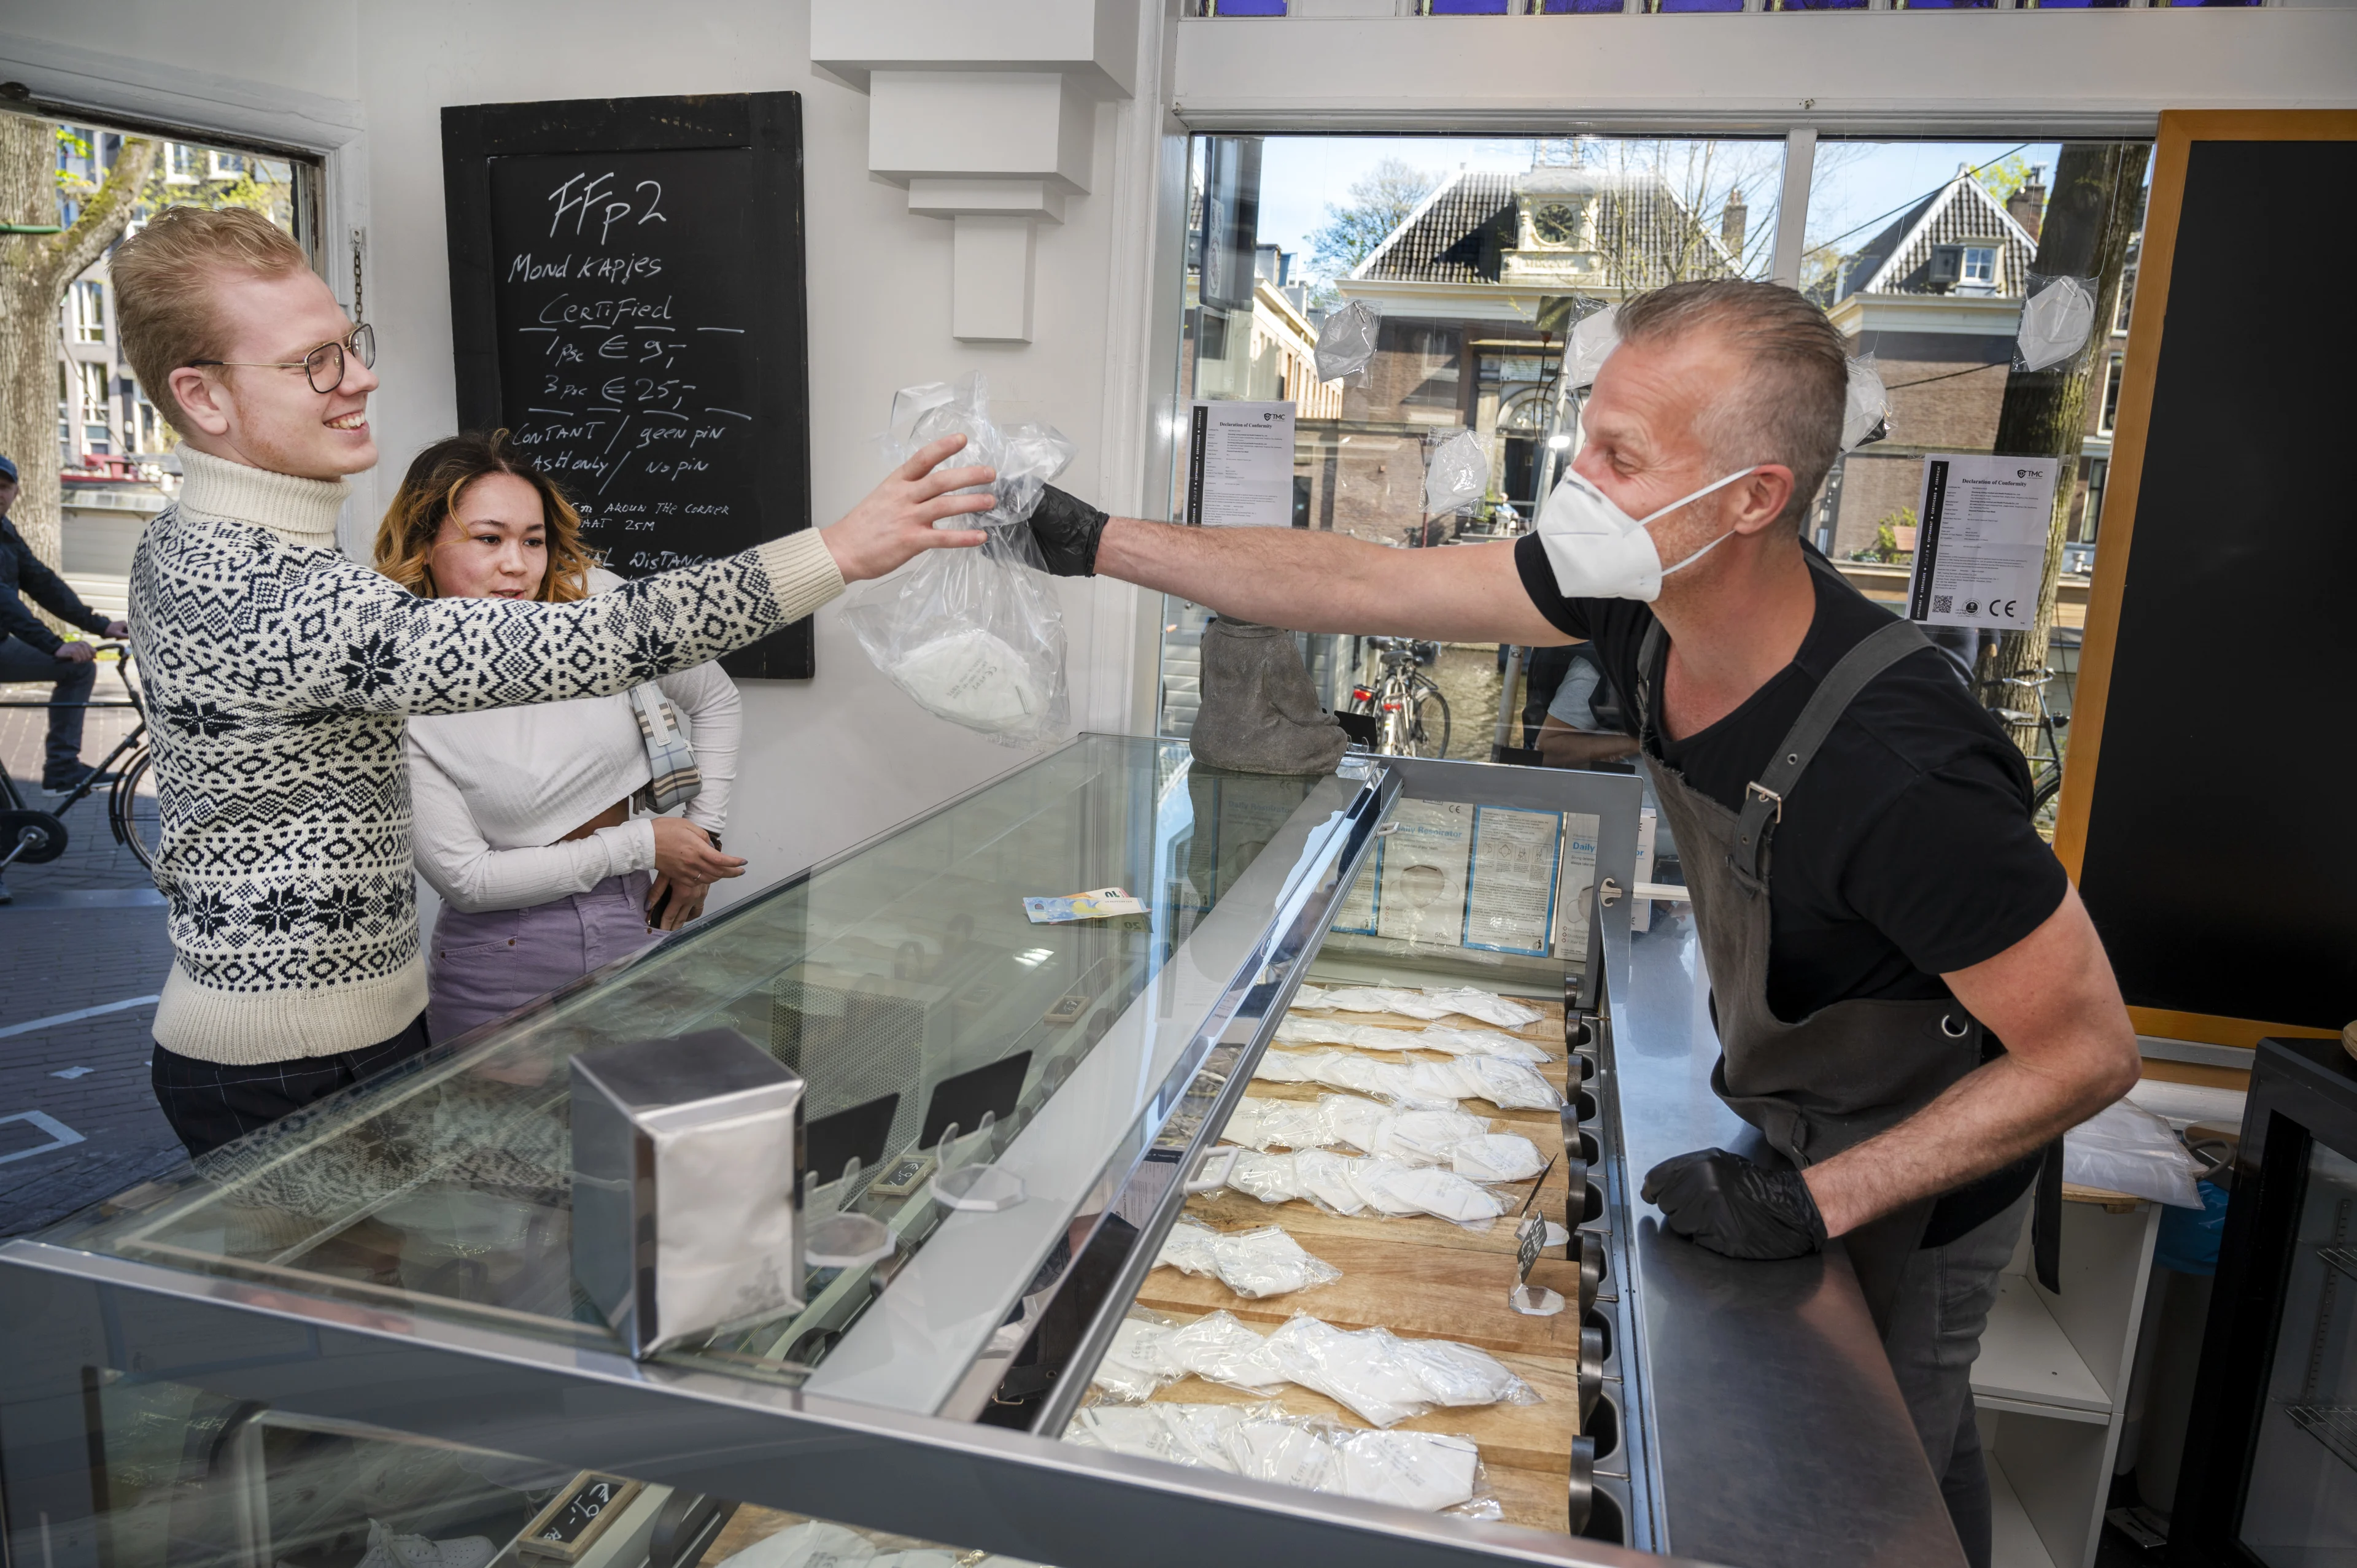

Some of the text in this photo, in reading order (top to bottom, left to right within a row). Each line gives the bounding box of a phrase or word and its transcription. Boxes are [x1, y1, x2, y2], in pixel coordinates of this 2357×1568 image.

[598, 334, 629, 358] €
[544, 374, 559, 393] 3
[602, 376, 626, 403] €
[525, 451, 573, 472] ASH
[1449, 805, 1461, 814] CE
[1418, 826, 1462, 838] Respirator
[1573, 841, 1595, 853] Daily
